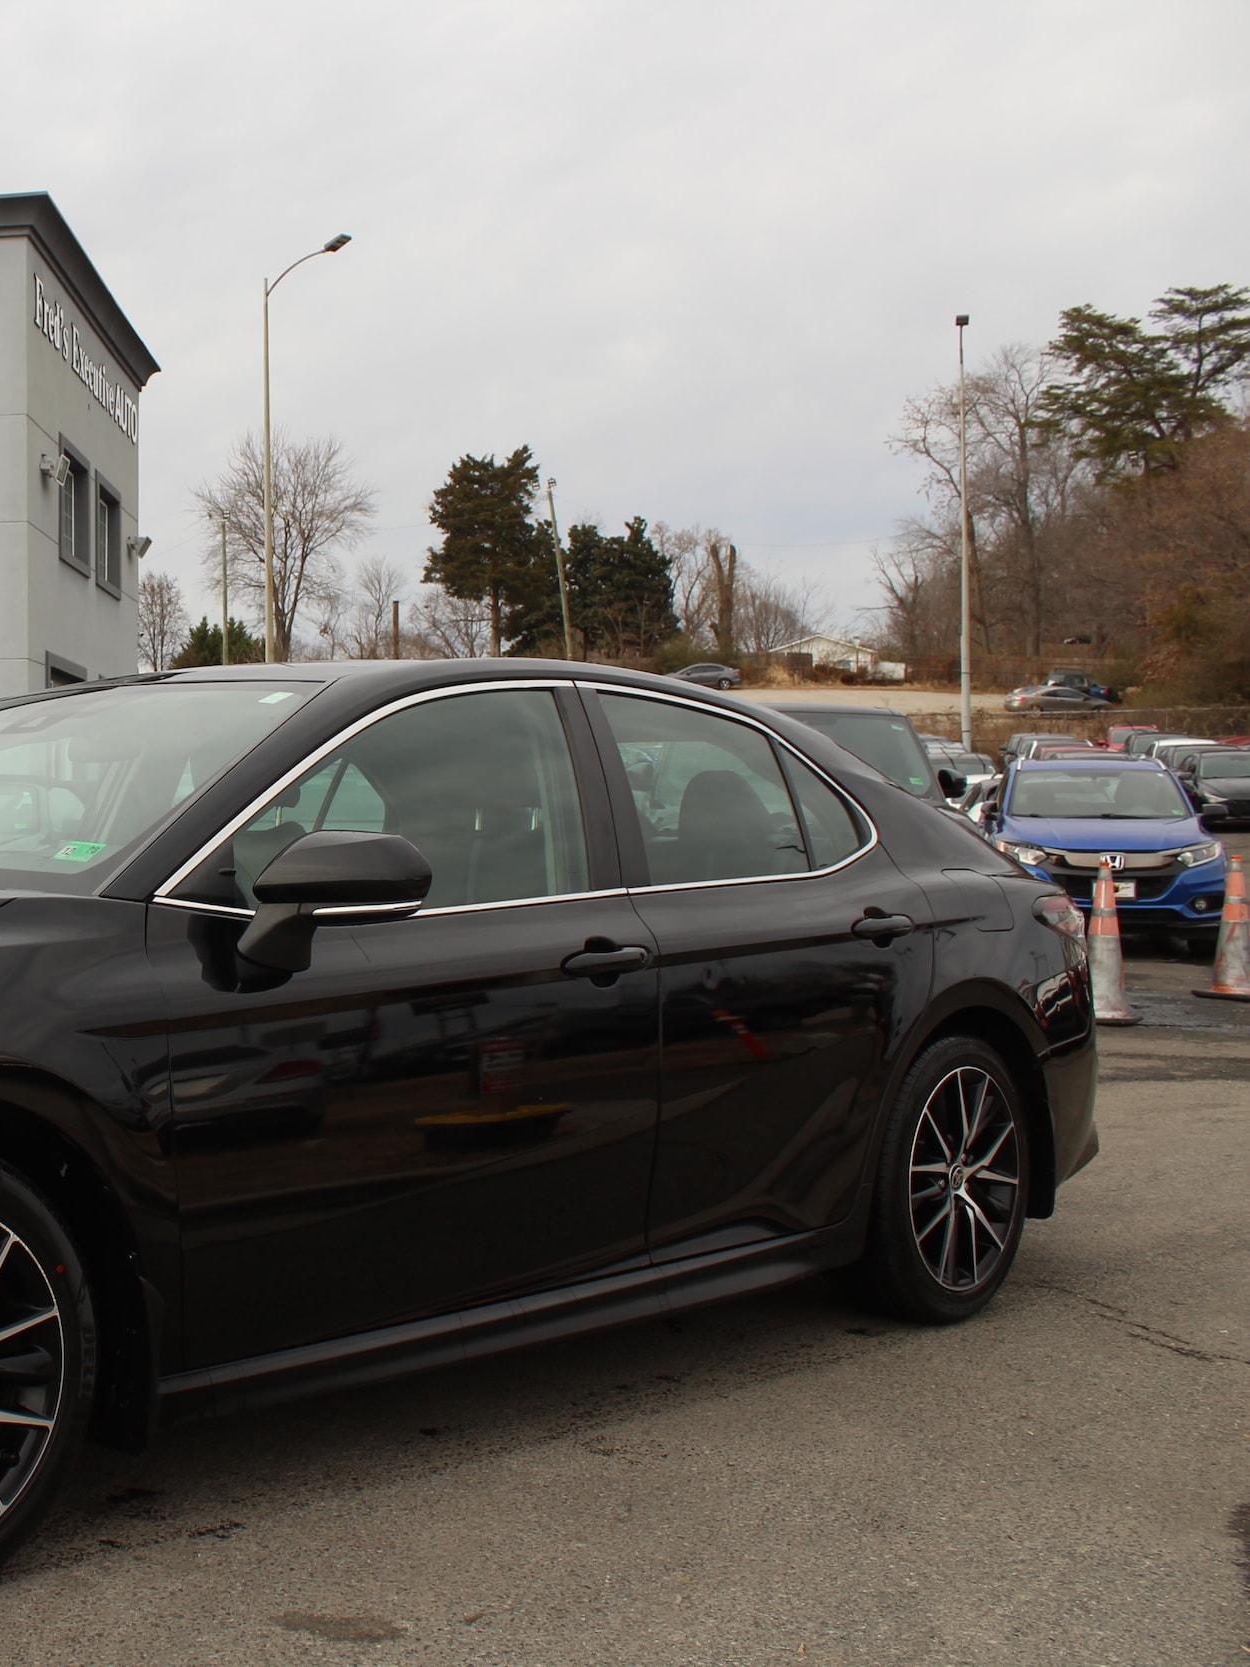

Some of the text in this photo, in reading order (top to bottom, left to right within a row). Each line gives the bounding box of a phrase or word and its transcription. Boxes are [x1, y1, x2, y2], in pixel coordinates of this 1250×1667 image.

[34, 273, 138, 445] Fred's Executive AUTO
